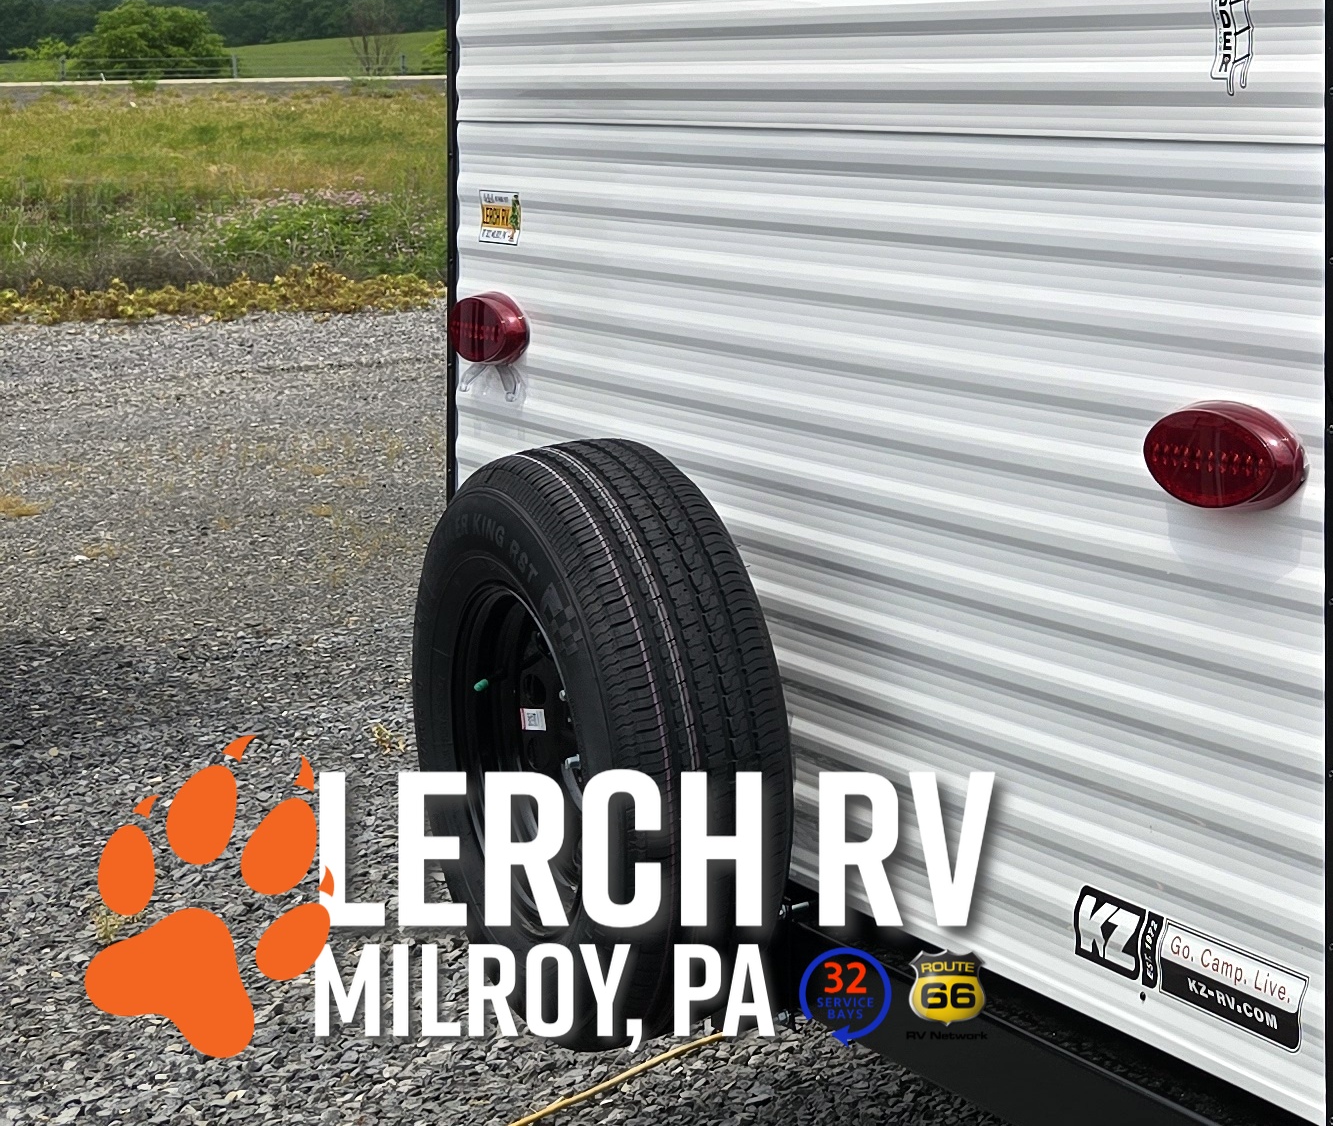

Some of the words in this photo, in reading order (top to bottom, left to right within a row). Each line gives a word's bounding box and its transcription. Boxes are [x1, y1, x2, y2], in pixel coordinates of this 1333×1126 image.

[1078, 894, 1141, 972] KZ
[1170, 936, 1194, 962] Go.
[1200, 948, 1247, 985] Camp.
[1254, 969, 1290, 1004] Live.
[1187, 977, 1278, 1030] KZ-RV.COM
